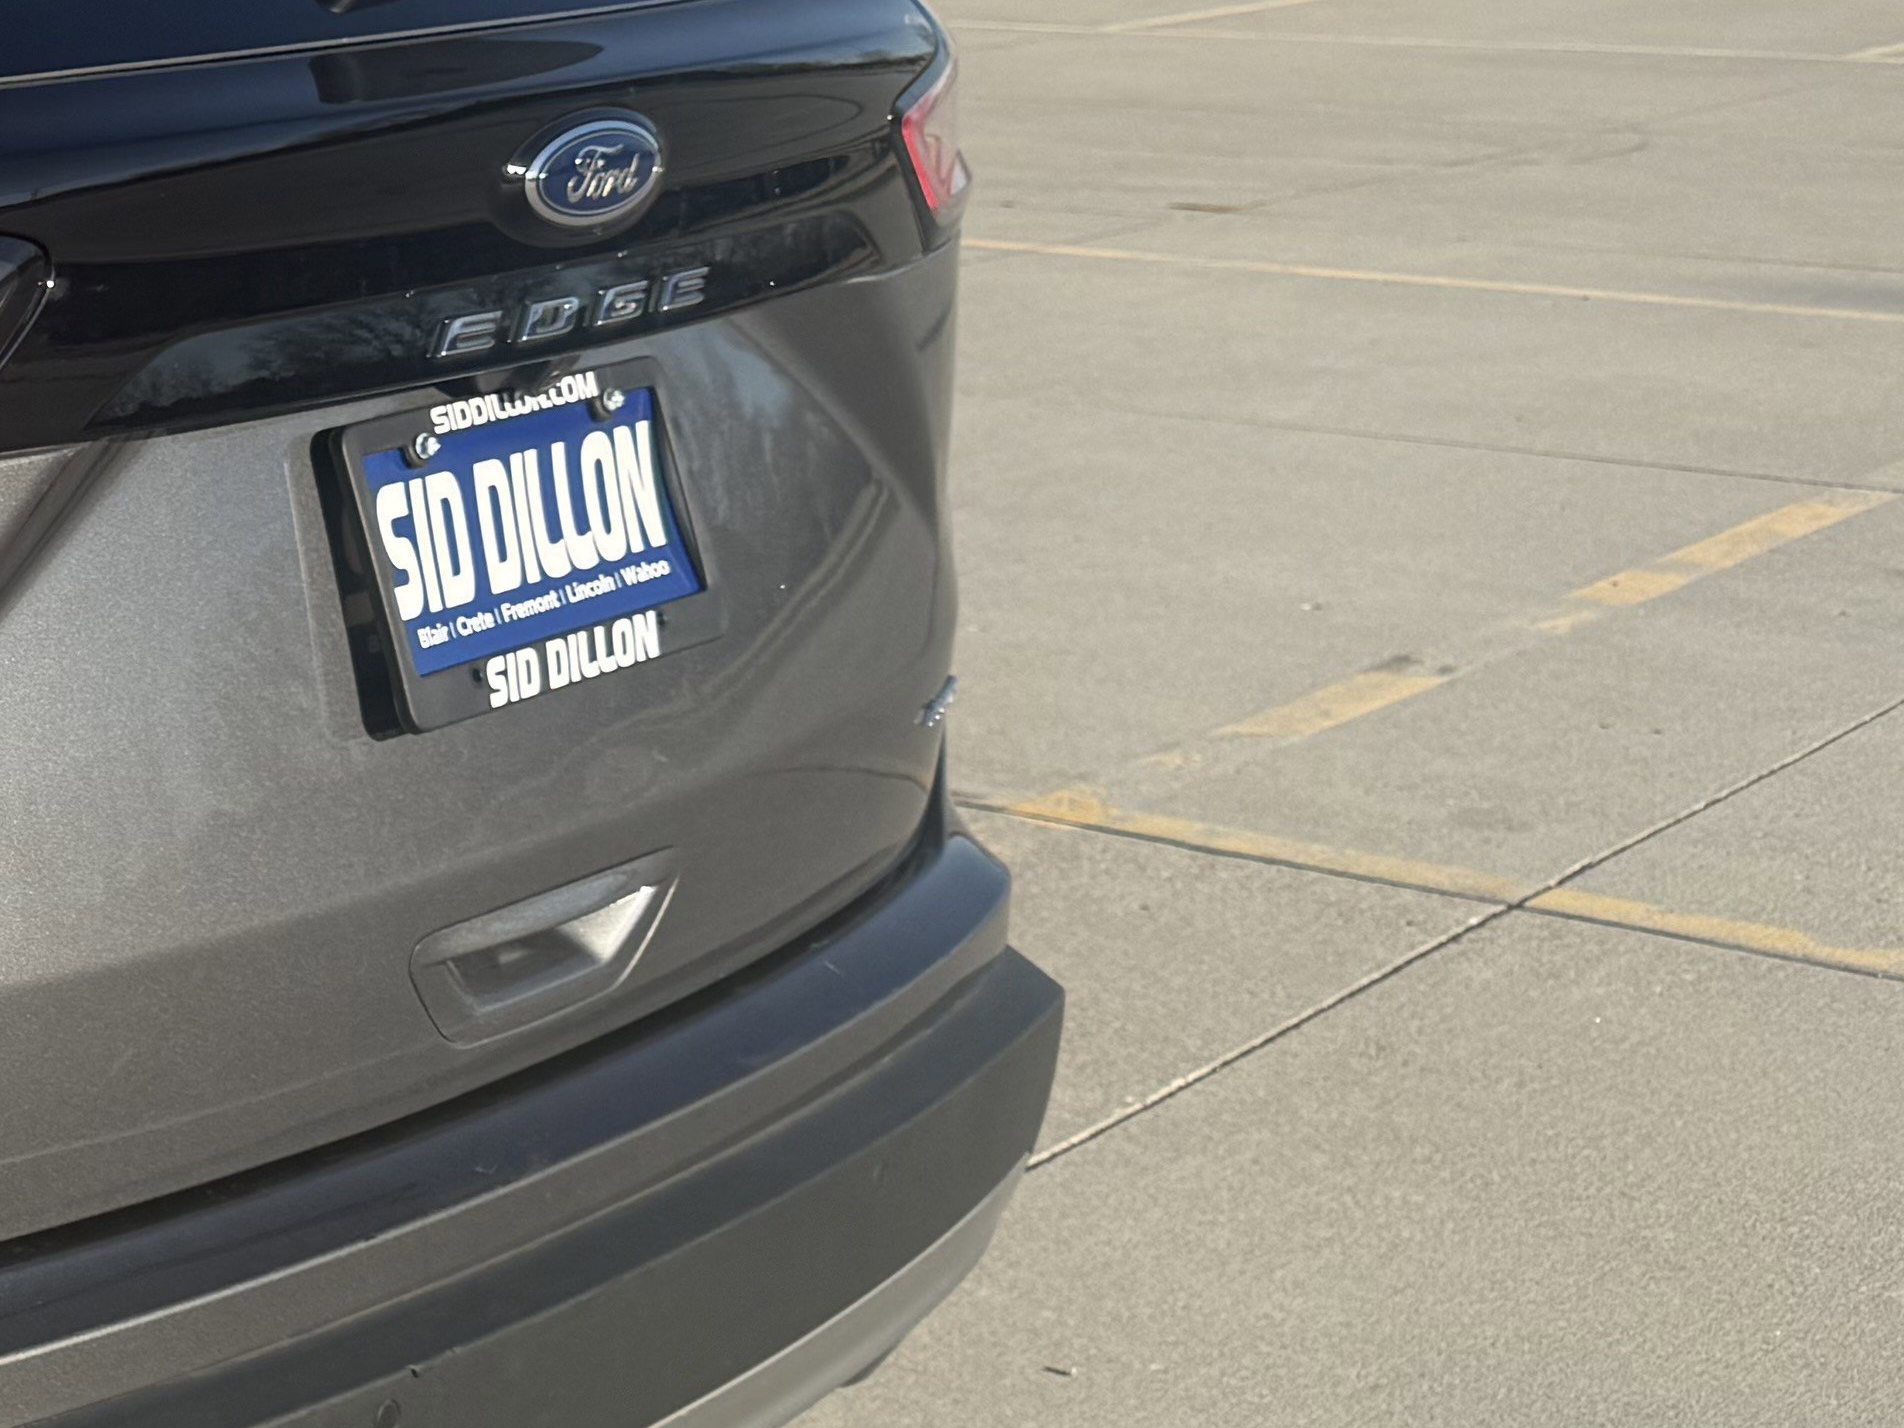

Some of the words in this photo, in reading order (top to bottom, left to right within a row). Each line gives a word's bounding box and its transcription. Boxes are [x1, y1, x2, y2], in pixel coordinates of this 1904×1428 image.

[566, 144, 640, 204] Ford
[436, 266, 711, 357] EDGE
[376, 470, 476, 621] SID
[473, 420, 668, 595] DILLON
[417, 625, 450, 649] Blair
[456, 611, 495, 637] Crete
[501, 589, 561, 622] Fremont
[565, 574, 617, 604] Lincoln
[620, 559, 671, 587] Wahoo
[486, 650, 542, 709] SID
[545, 610, 661, 690] DILLON
